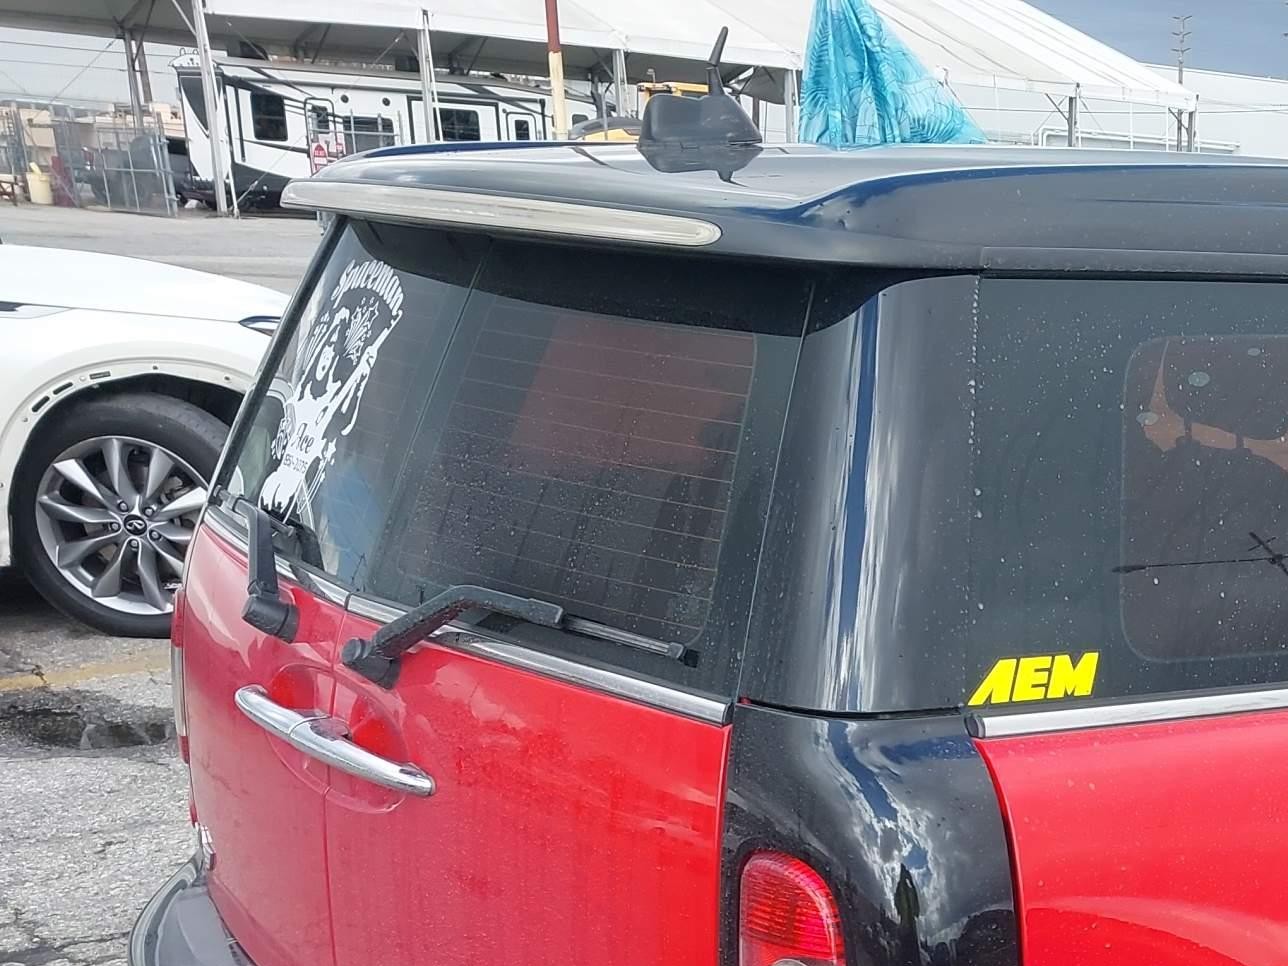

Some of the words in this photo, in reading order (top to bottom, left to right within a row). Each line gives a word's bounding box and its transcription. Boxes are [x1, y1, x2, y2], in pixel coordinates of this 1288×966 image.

[331, 260, 404, 315] Spaceman
[290, 422, 315, 454] Ace
[967, 652, 1099, 706] AEM
